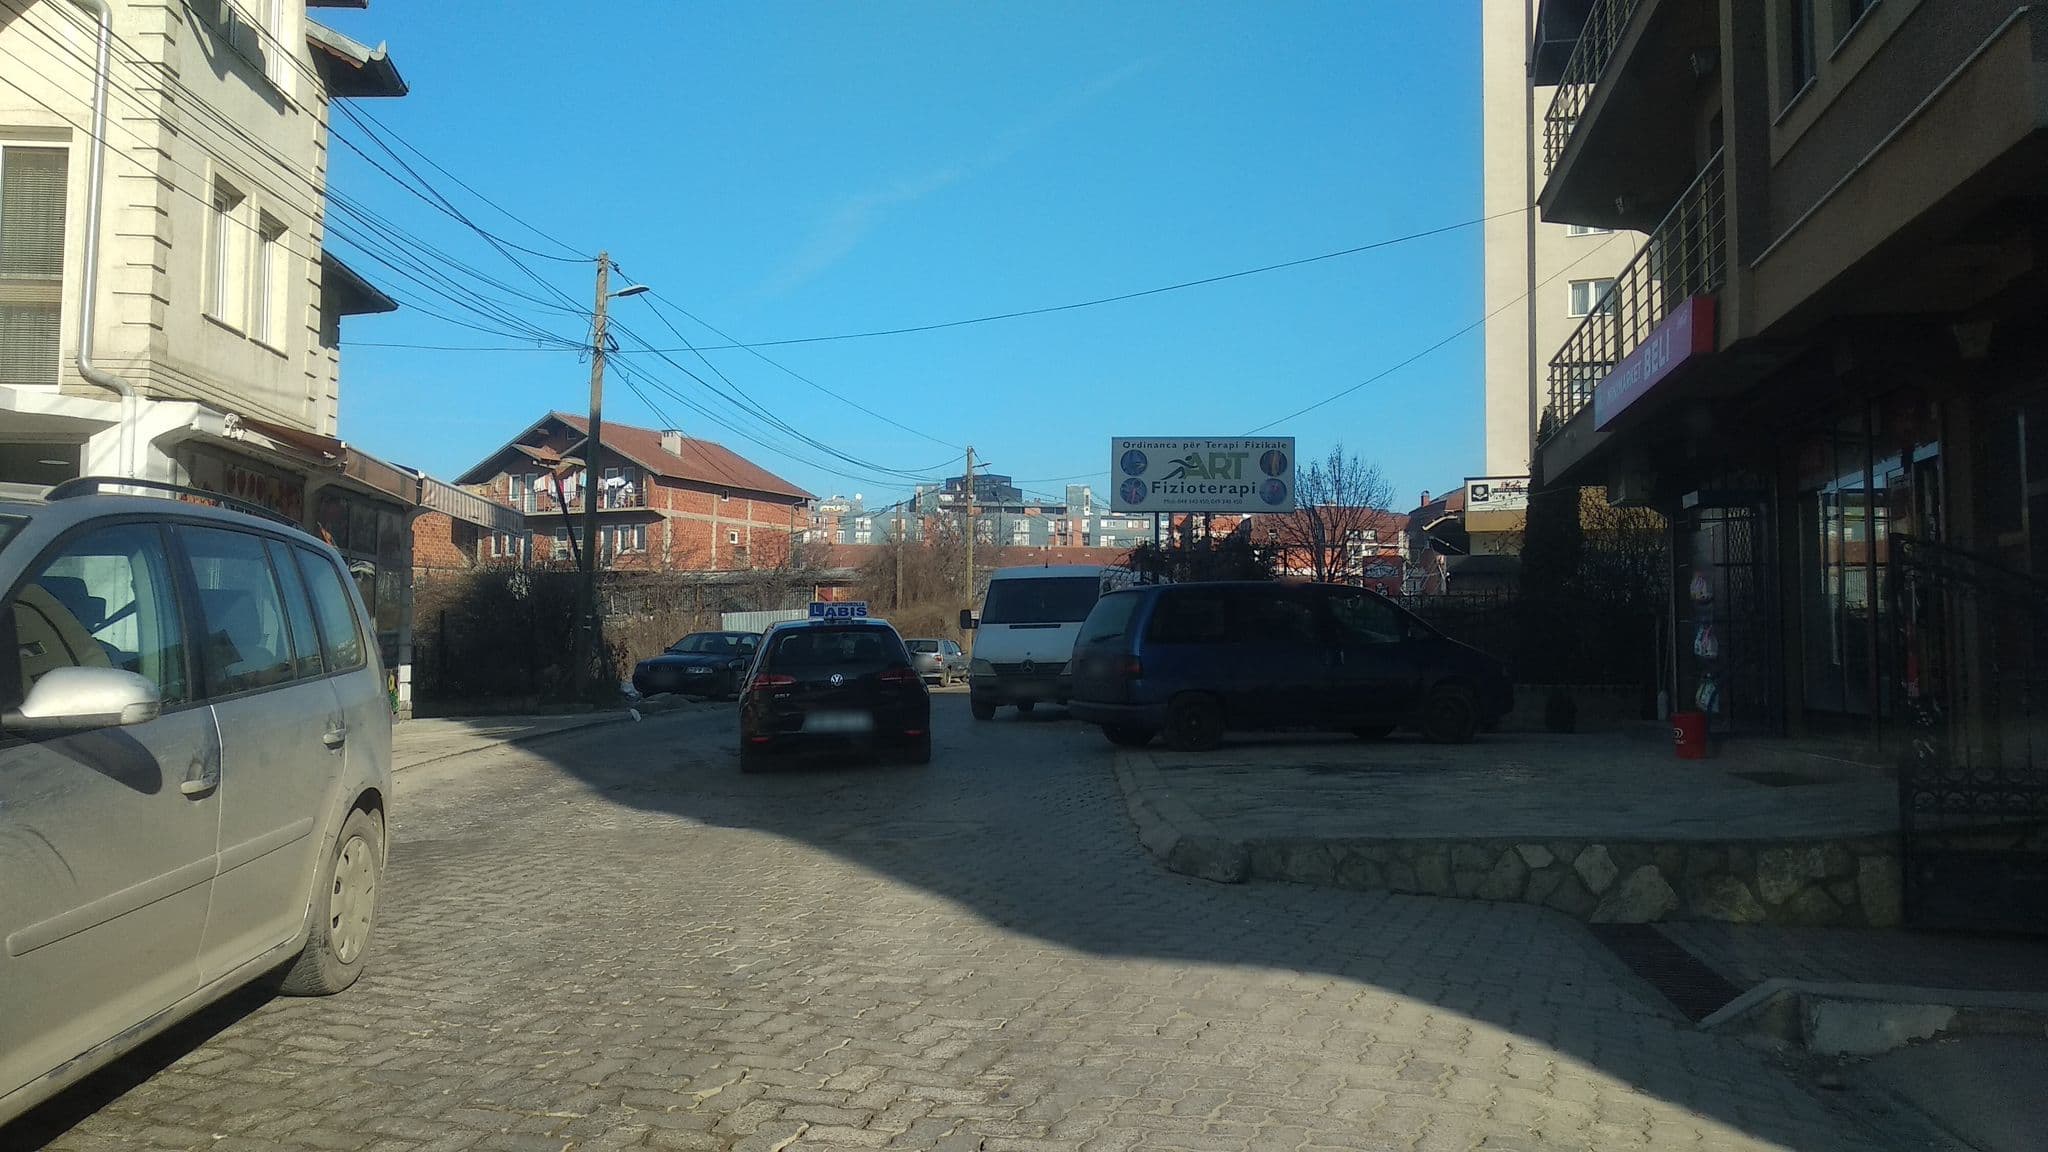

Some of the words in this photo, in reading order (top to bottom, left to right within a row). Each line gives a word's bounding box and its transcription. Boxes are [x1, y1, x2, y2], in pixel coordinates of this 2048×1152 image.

[1643, 328, 1670, 381] BELI
[1123, 441, 1177, 449] Ordinanca
[1205, 441, 1239, 451] Terapi
[1244, 441, 1287, 449] Fizikale
[1184, 452, 1249, 480] ART
[1151, 481, 1256, 498] Fizioterapi
